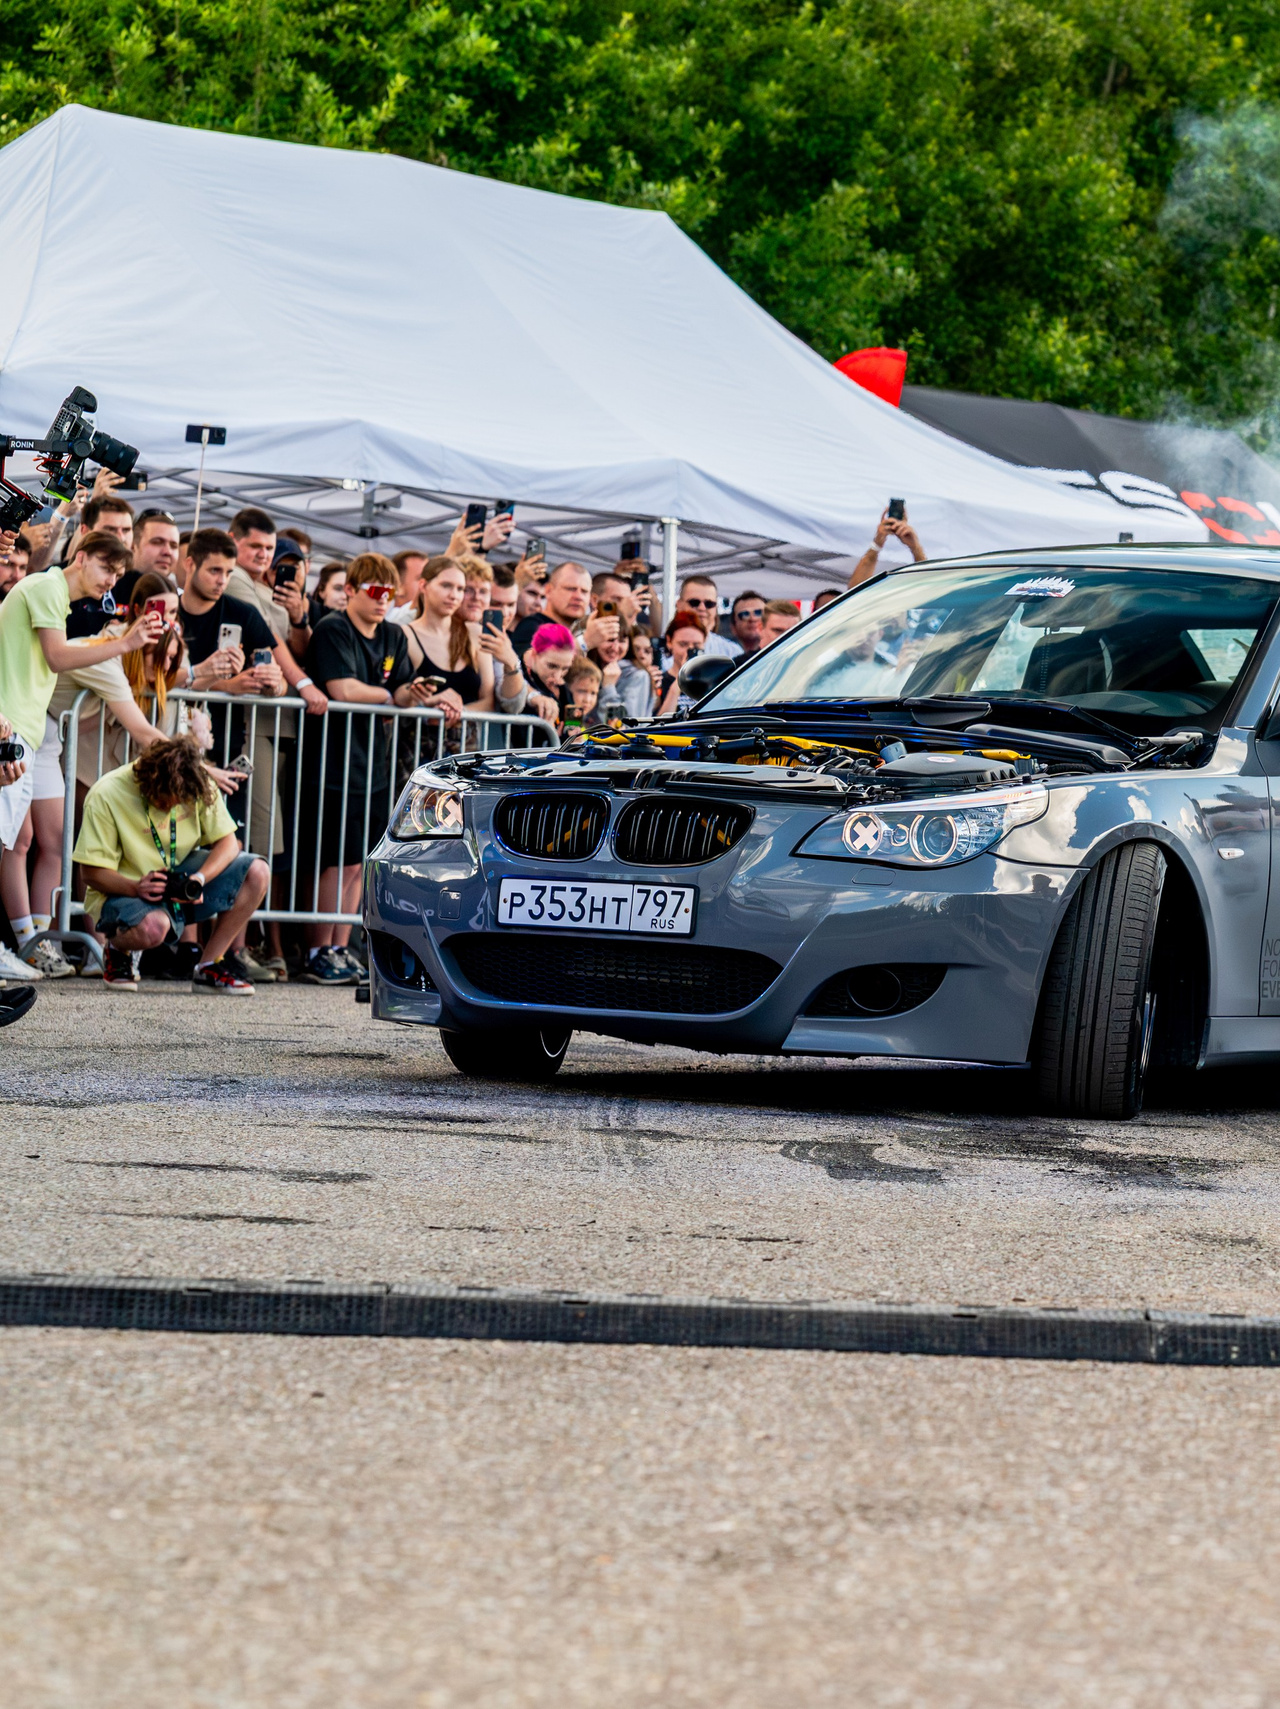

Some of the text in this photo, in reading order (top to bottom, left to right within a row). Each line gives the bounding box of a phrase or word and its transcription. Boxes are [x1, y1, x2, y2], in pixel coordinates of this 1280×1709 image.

[10, 440, 35, 449] RONIN
[508, 885, 686, 925] P353HT 797
[650, 918, 675, 930] RUS
